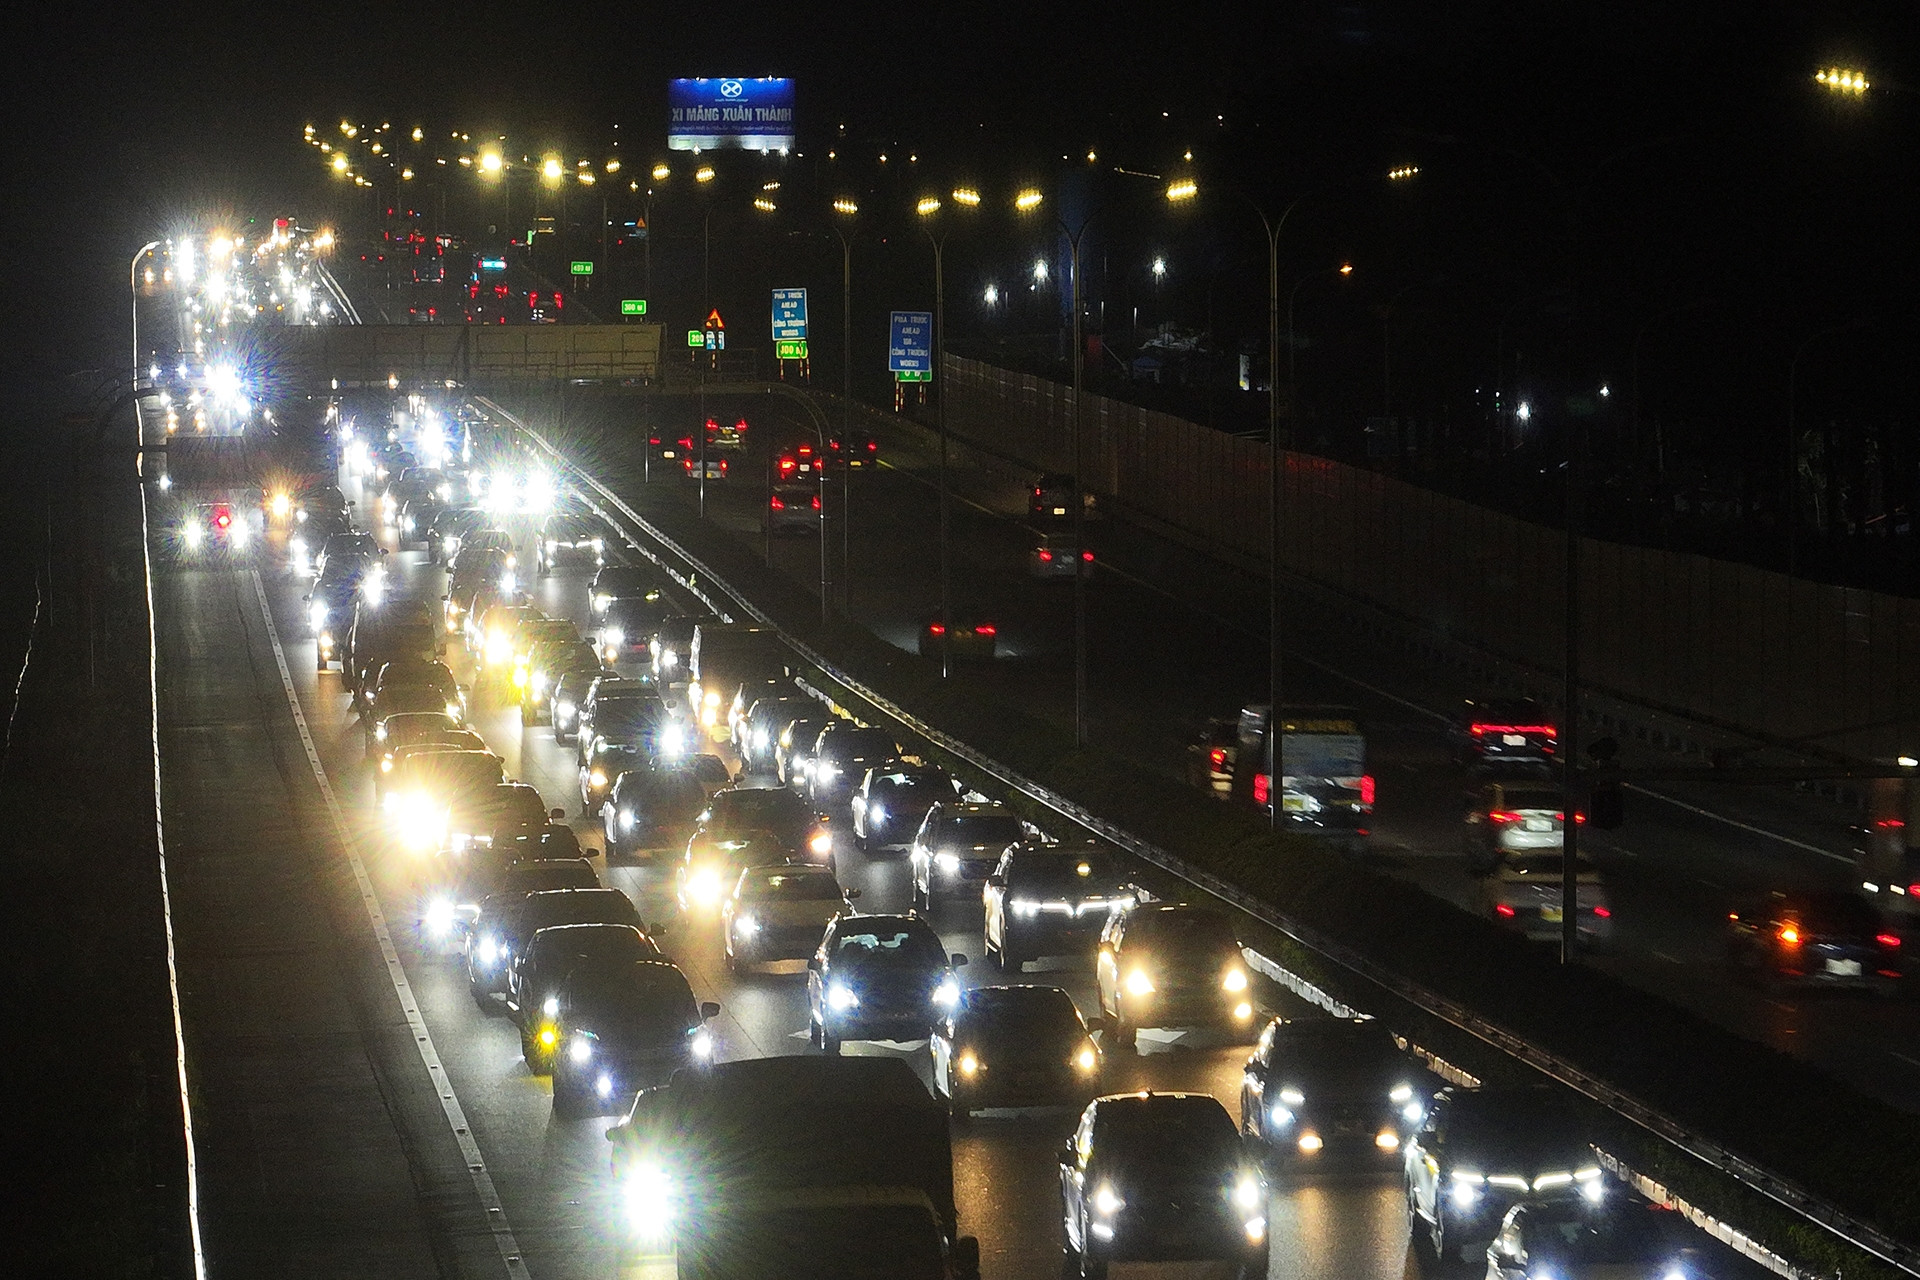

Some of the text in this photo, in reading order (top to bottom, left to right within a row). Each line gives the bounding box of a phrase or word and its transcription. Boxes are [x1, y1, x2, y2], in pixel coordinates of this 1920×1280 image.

[672, 105, 792, 121] XI MĂNG XUÂN THÀNH
[624, 303, 636, 311] 300
[902, 327, 920, 335] AHEAD
[691, 334, 704, 343] 200
[781, 345, 794, 355] 100
